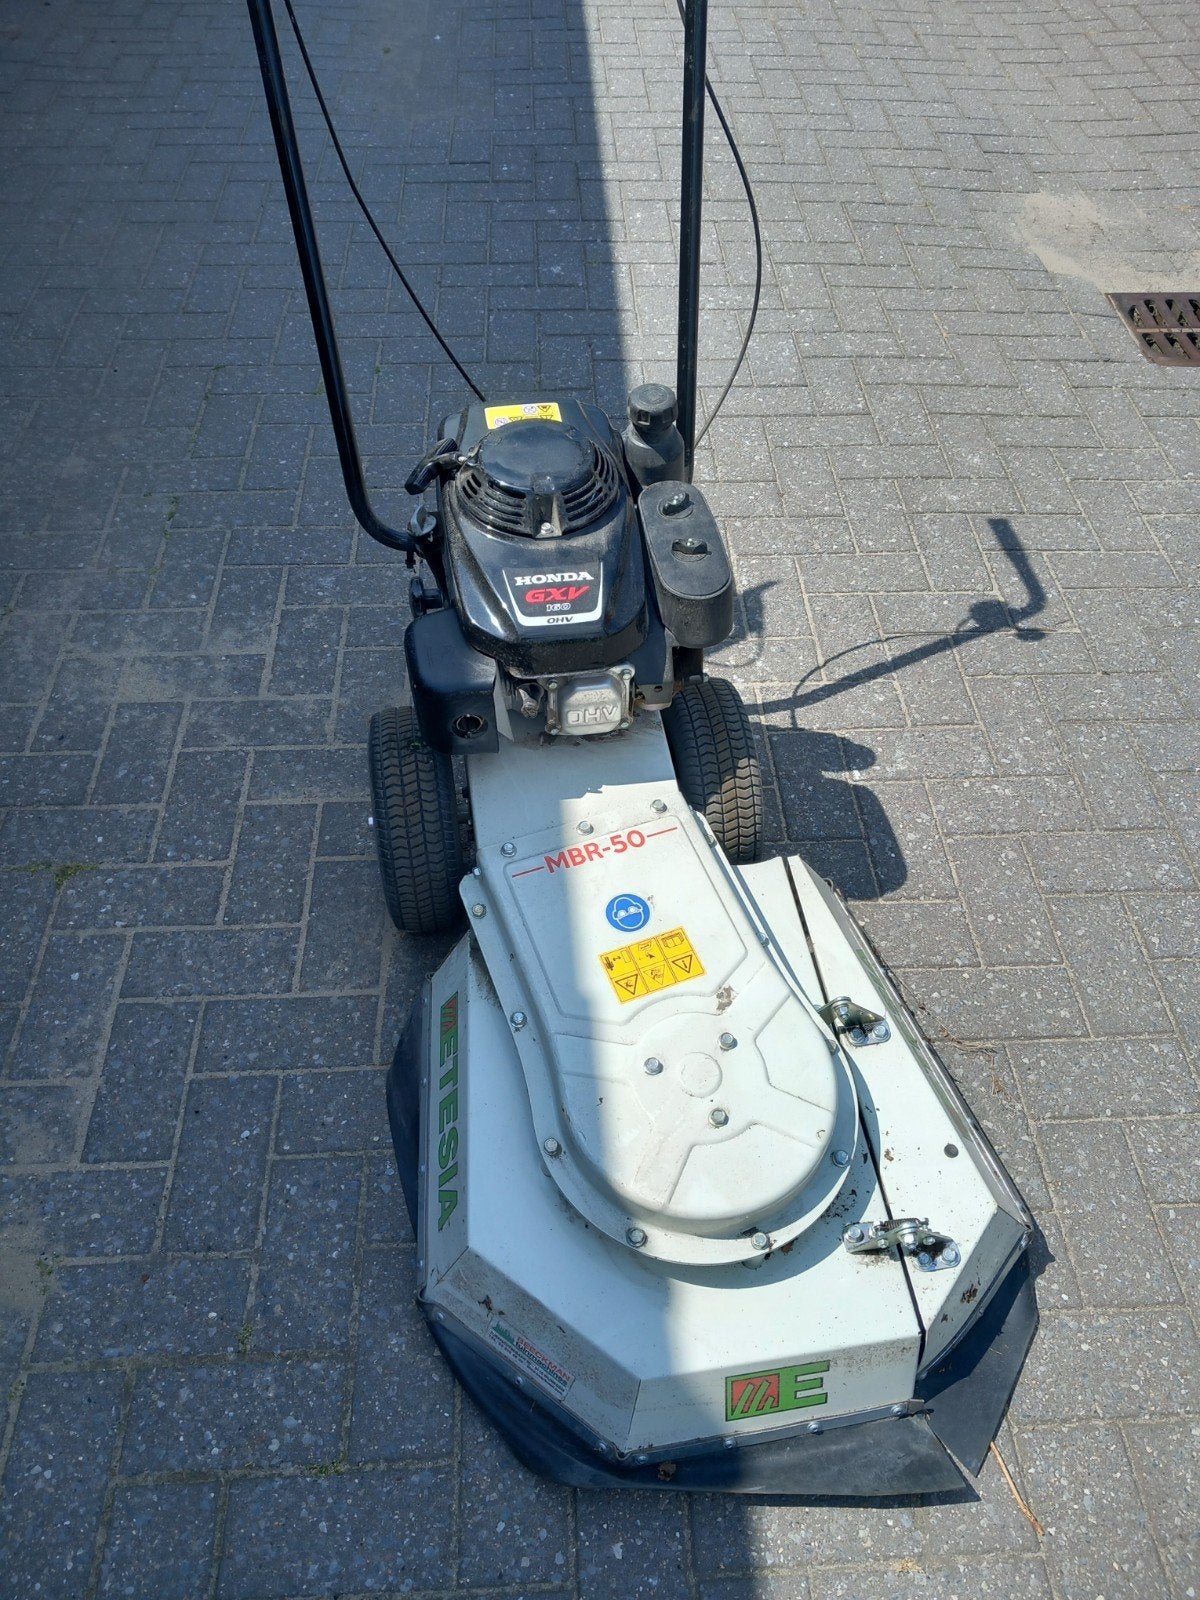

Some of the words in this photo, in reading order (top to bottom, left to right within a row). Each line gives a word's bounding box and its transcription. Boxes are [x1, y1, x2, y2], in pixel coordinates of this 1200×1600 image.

[514, 571, 594, 586] HONDA
[525, 585, 590, 603] GXV
[546, 602, 571, 612] 160
[546, 616, 573, 624] OHV
[543, 829, 646, 873] MBR-50
[438, 1030, 459, 1232] ETESIA
